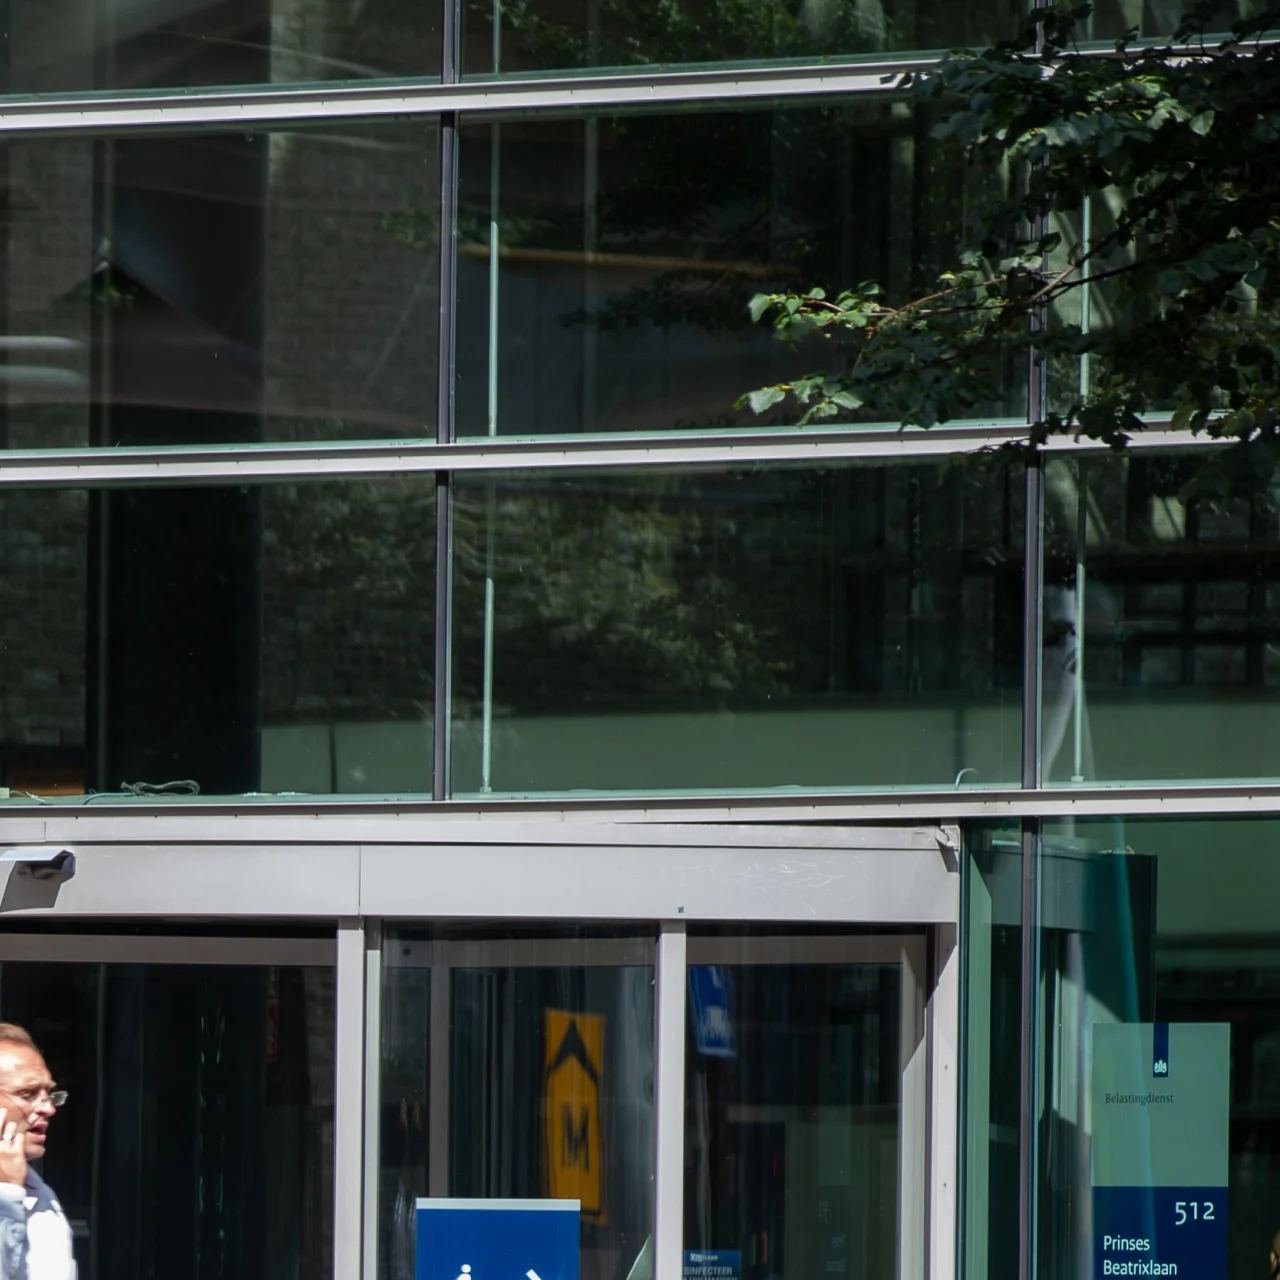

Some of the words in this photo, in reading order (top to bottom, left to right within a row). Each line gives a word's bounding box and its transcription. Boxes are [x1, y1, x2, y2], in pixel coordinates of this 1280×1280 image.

[1105, 1092, 1174, 1106] Belastingdienst
[1175, 1202, 1215, 1225] 512
[1103, 1235, 1150, 1251] Prinses
[1103, 1259, 1177, 1276] Beatrixlaan
